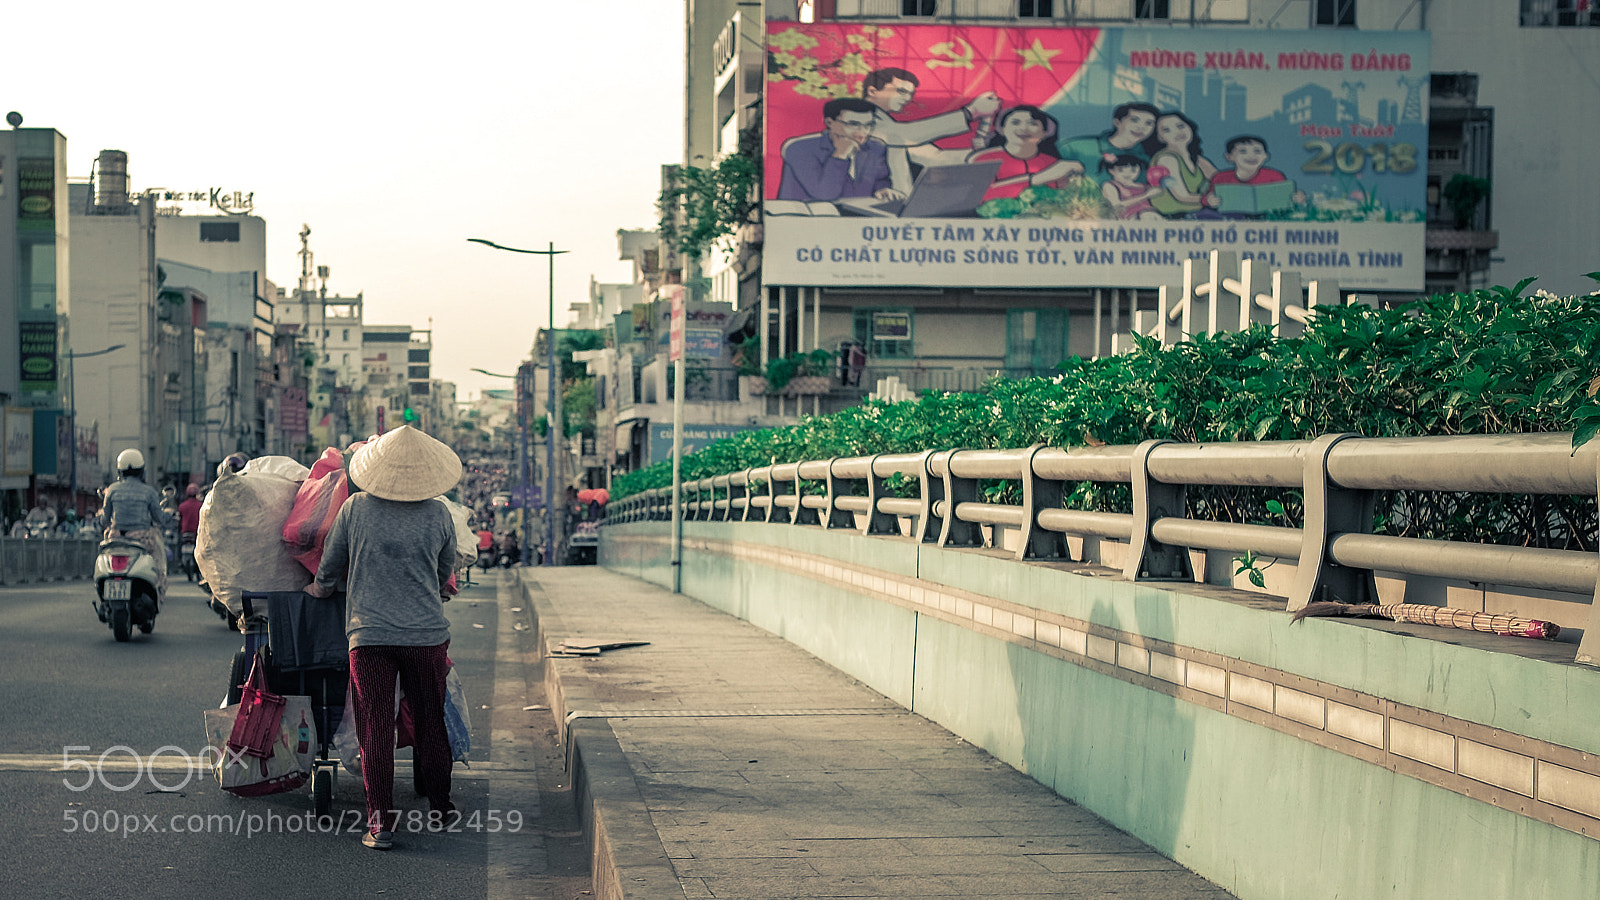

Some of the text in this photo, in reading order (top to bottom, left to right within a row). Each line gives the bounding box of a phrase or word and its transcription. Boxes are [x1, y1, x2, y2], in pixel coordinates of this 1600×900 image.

[1130, 47, 1197, 69] MỪNG
[1204, 48, 1271, 71] XUÂN,
[1278, 49, 1344, 71] MỪNG
[1302, 139, 1418, 174] 2018
[862, 221, 926, 243] QUYẾT
[931, 224, 975, 243] TÂM
[982, 224, 1021, 243] XÂY
[1028, 226, 1084, 247] DỰNG
[1091, 225, 1160, 244] THÀNH
[1164, 223, 1205, 245] PHỐ
[1245, 226, 1279, 245] CHÍ
[1285, 229, 1339, 246] MINH
[796, 244, 823, 263] CÓ
[830, 243, 882, 263] CHẤT
[889, 246, 956, 267] LƯỢNG
[963, 243, 1018, 265] SỐNG
[1074, 247, 1114, 266] VĂN
[1121, 250, 1181, 267] MINH,
[1289, 249, 1350, 268] NGHĨA
[1353, 249, 1403, 268] TÌNH
